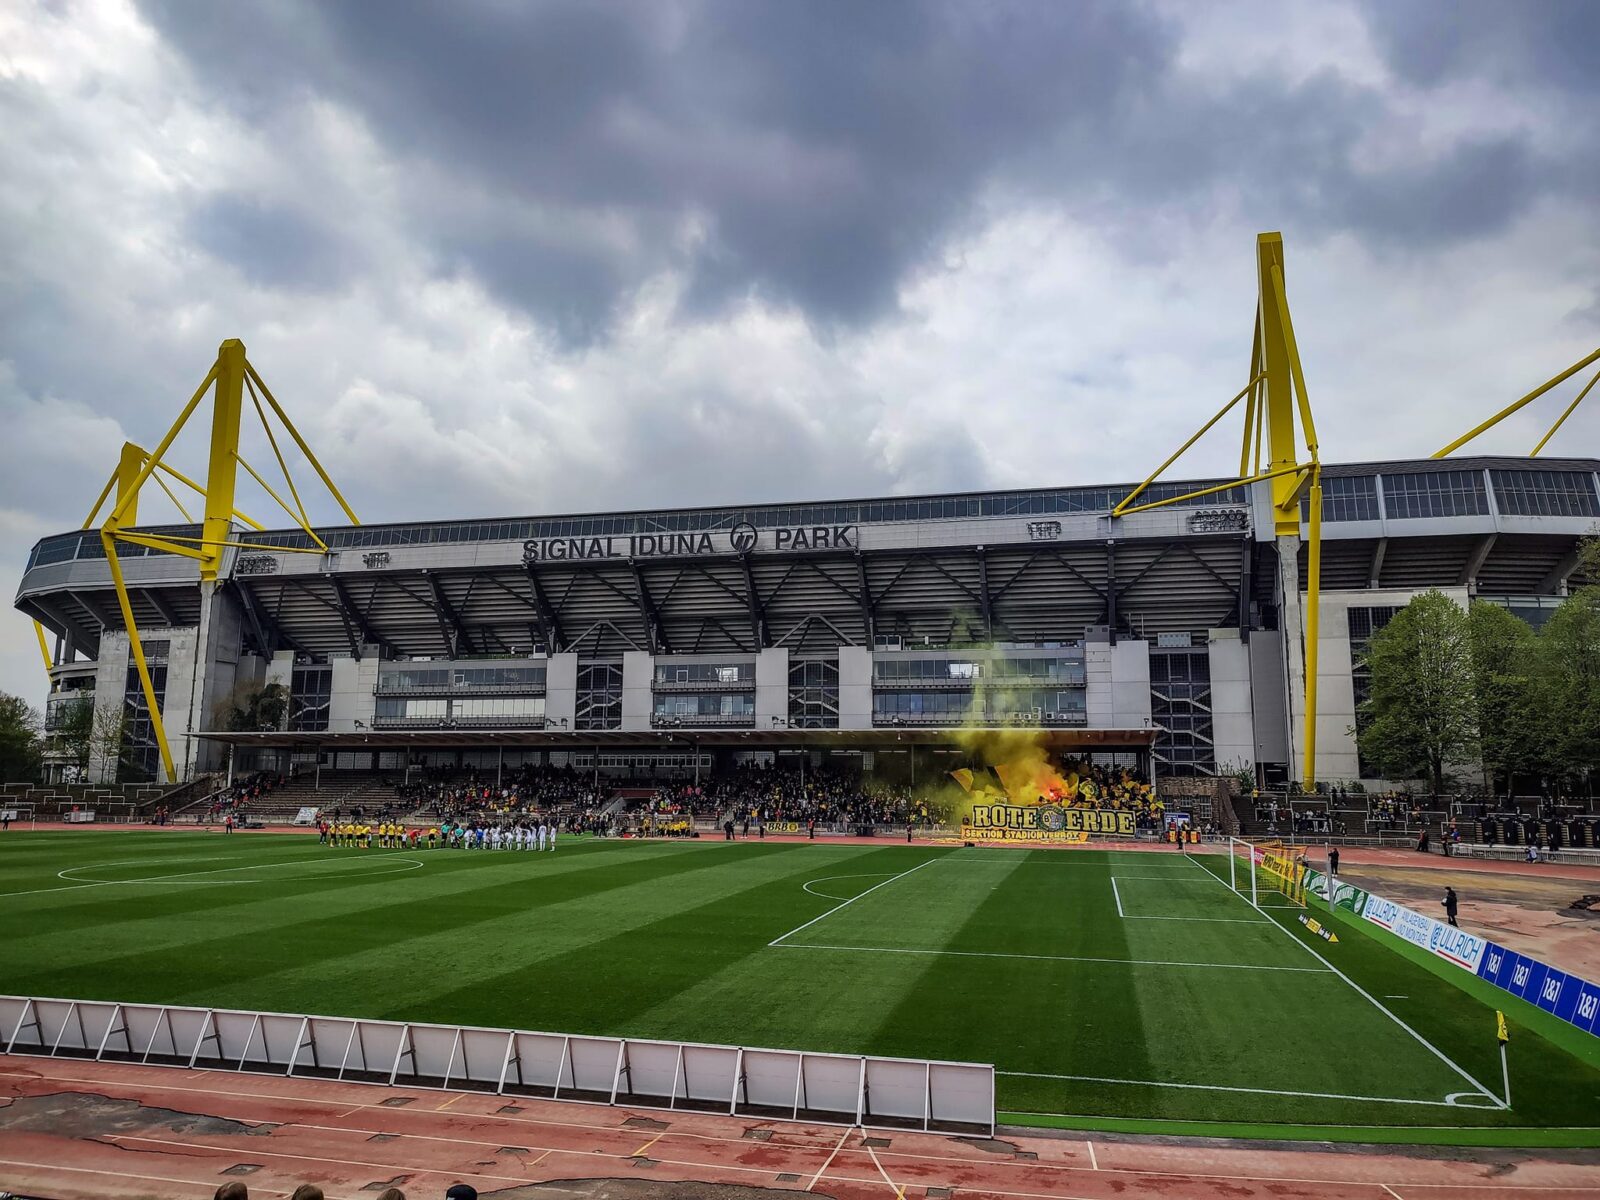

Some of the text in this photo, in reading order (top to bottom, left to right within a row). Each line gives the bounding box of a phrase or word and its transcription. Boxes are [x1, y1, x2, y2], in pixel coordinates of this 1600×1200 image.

[523, 525, 851, 561] SIGNAL IDUNA PARK
[768, 821, 789, 831] BRB
[973, 805, 1038, 829] ROTE
[1064, 808, 1136, 834] ERDE
[965, 829, 1003, 839] SEKTION
[1371, 899, 1399, 922] ULLRICH
[1439, 926, 1482, 962] ULLRICH
[1487, 953, 1501, 974] 1&1
[1513, 964, 1529, 987] 1&1
[1542, 977, 1561, 1002] 1&1
[1577, 992, 1598, 1020] 1&1
